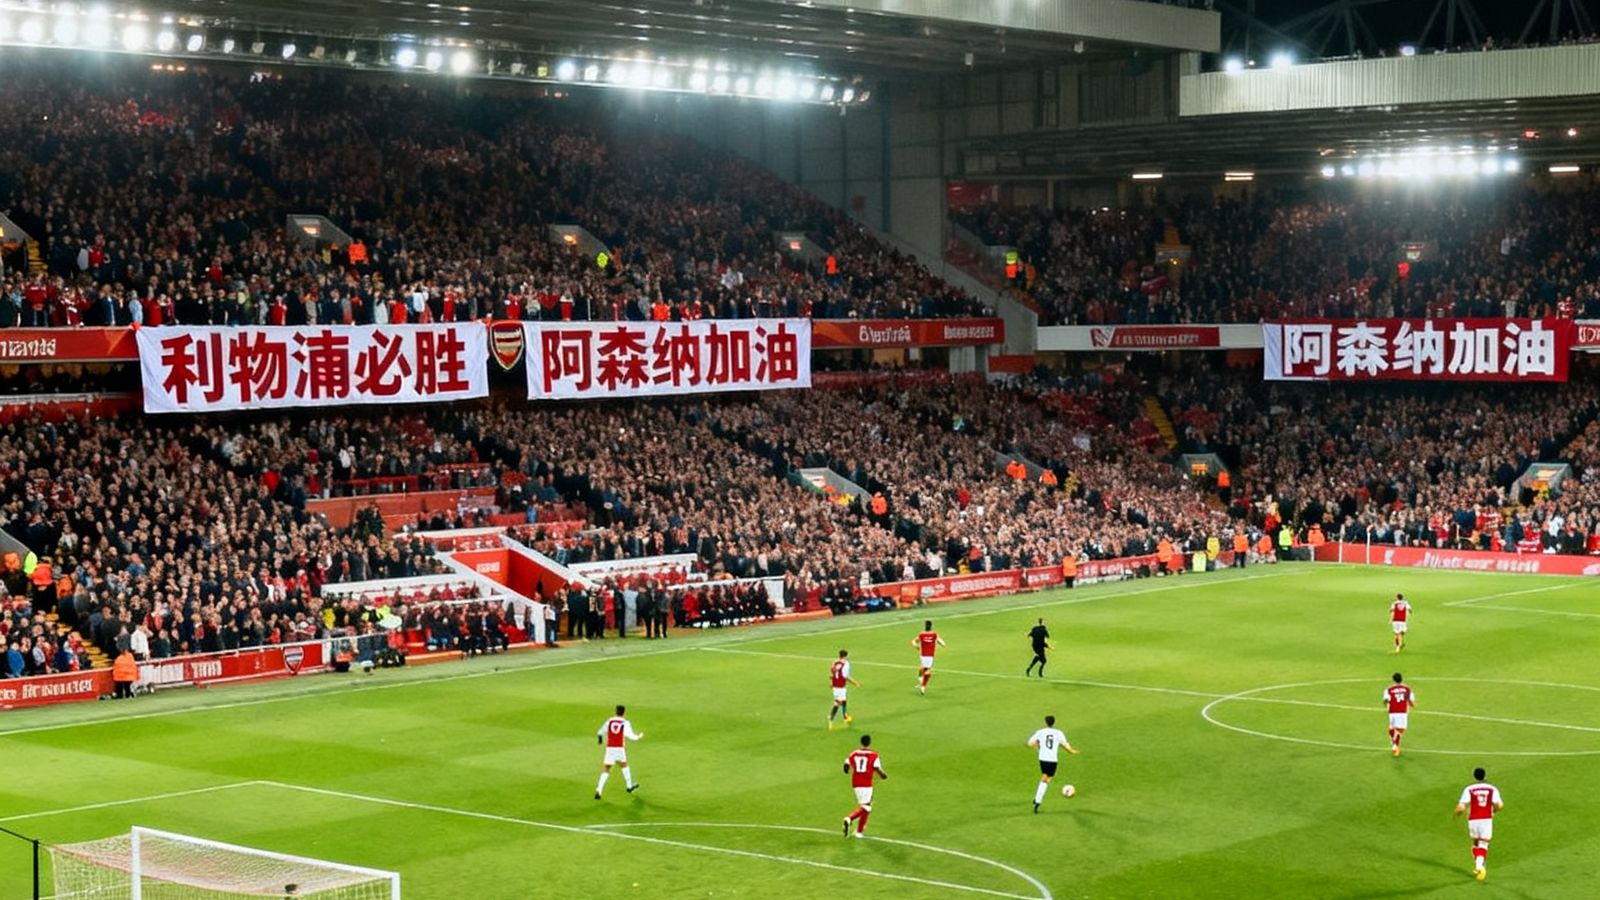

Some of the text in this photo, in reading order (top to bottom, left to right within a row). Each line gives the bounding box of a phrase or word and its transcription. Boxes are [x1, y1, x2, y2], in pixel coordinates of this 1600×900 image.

[541, 323, 798, 393] 阿森纳加油
[1284, 320, 1555, 376] 阿森纳加油
